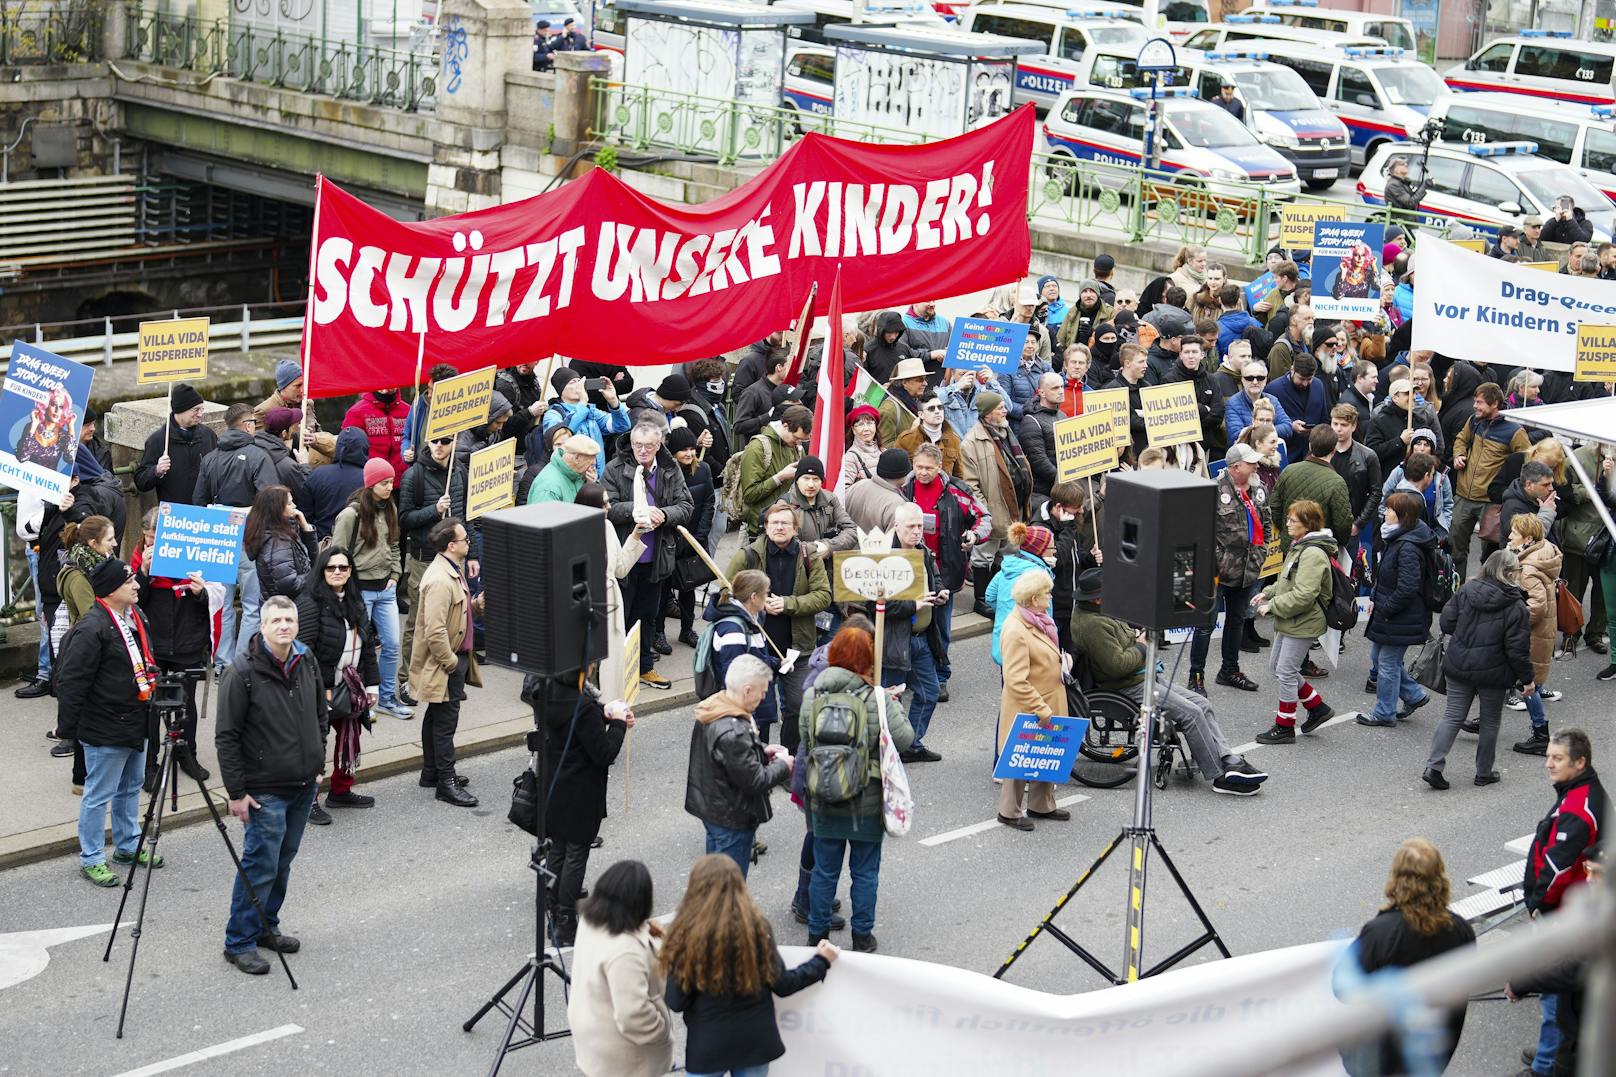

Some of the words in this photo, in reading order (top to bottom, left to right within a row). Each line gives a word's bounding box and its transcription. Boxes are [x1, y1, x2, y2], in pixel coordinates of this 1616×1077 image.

[1470, 131, 1486, 144] 133
[1285, 213, 1314, 223] VILLA
[1317, 214, 1342, 223] VIDA
[1283, 225, 1314, 234] ZUSPE
[1319, 227, 1341, 237] DRAG
[1340, 229, 1366, 239] QUEEN
[313, 225, 586, 333] SCHÜTZT
[591, 202, 782, 303] UNSERE
[787, 160, 995, 259] KINDER!
[1318, 237, 1342, 247] STORY
[1315, 303, 1339, 312] NICHT
[1341, 304, 1350, 312] IN
[1351, 305, 1375, 313] WIEN.
[1433, 302, 1470, 320] vor
[1476, 304, 1559, 333] Kindern
[963, 322, 985, 331] Keine
[143, 333, 175, 347] VILLA
[178, 331, 205, 345] VIDA
[958, 340, 975, 350] mit
[975, 343, 1010, 354] meinen
[1581, 336, 1616, 348] VILLA
[141, 347, 205, 363] ZUSPERREN!
[956, 349, 1007, 364] Steuern
[16, 353, 42, 370] DRAG
[40, 360, 71, 380] QUEEN
[12, 367, 40, 385] STORY
[10, 382, 21, 392] FÜR
[21, 385, 47, 402] KINDER?
[436, 387, 464, 405] VILLA
[467, 380, 490, 396] VIDA
[432, 394, 490, 420] ZUSPERREN!
[1146, 399, 1171, 412] VILLA
[1172, 394, 1194, 407] VIDA
[1148, 410, 1198, 427] ZUSPERREN!
[1059, 430, 1087, 446] VILLA
[1088, 421, 1112, 436] VIDA
[1059, 436, 1114, 462] ZUSPERREN!
[473, 462, 495, 480] VILLA
[495, 453, 512, 470] VIDA
[22, 471, 34, 483] IN
[35, 475, 62, 495] WIEN.
[470, 471, 512, 497] ZUSPERREN!
[163, 515, 210, 534] Biologie
[212, 522, 239, 536] statt
[160, 531, 237, 548] Aufklärungsunterricht
[158, 542, 183, 559] der
[185, 545, 235, 565] Vielfalt
[844, 565, 912, 581] BESCHÜTZT
[1013, 742, 1030, 753] mit
[1030, 744, 1065, 756] meinen
[1008, 753, 1061, 771] Steuern
